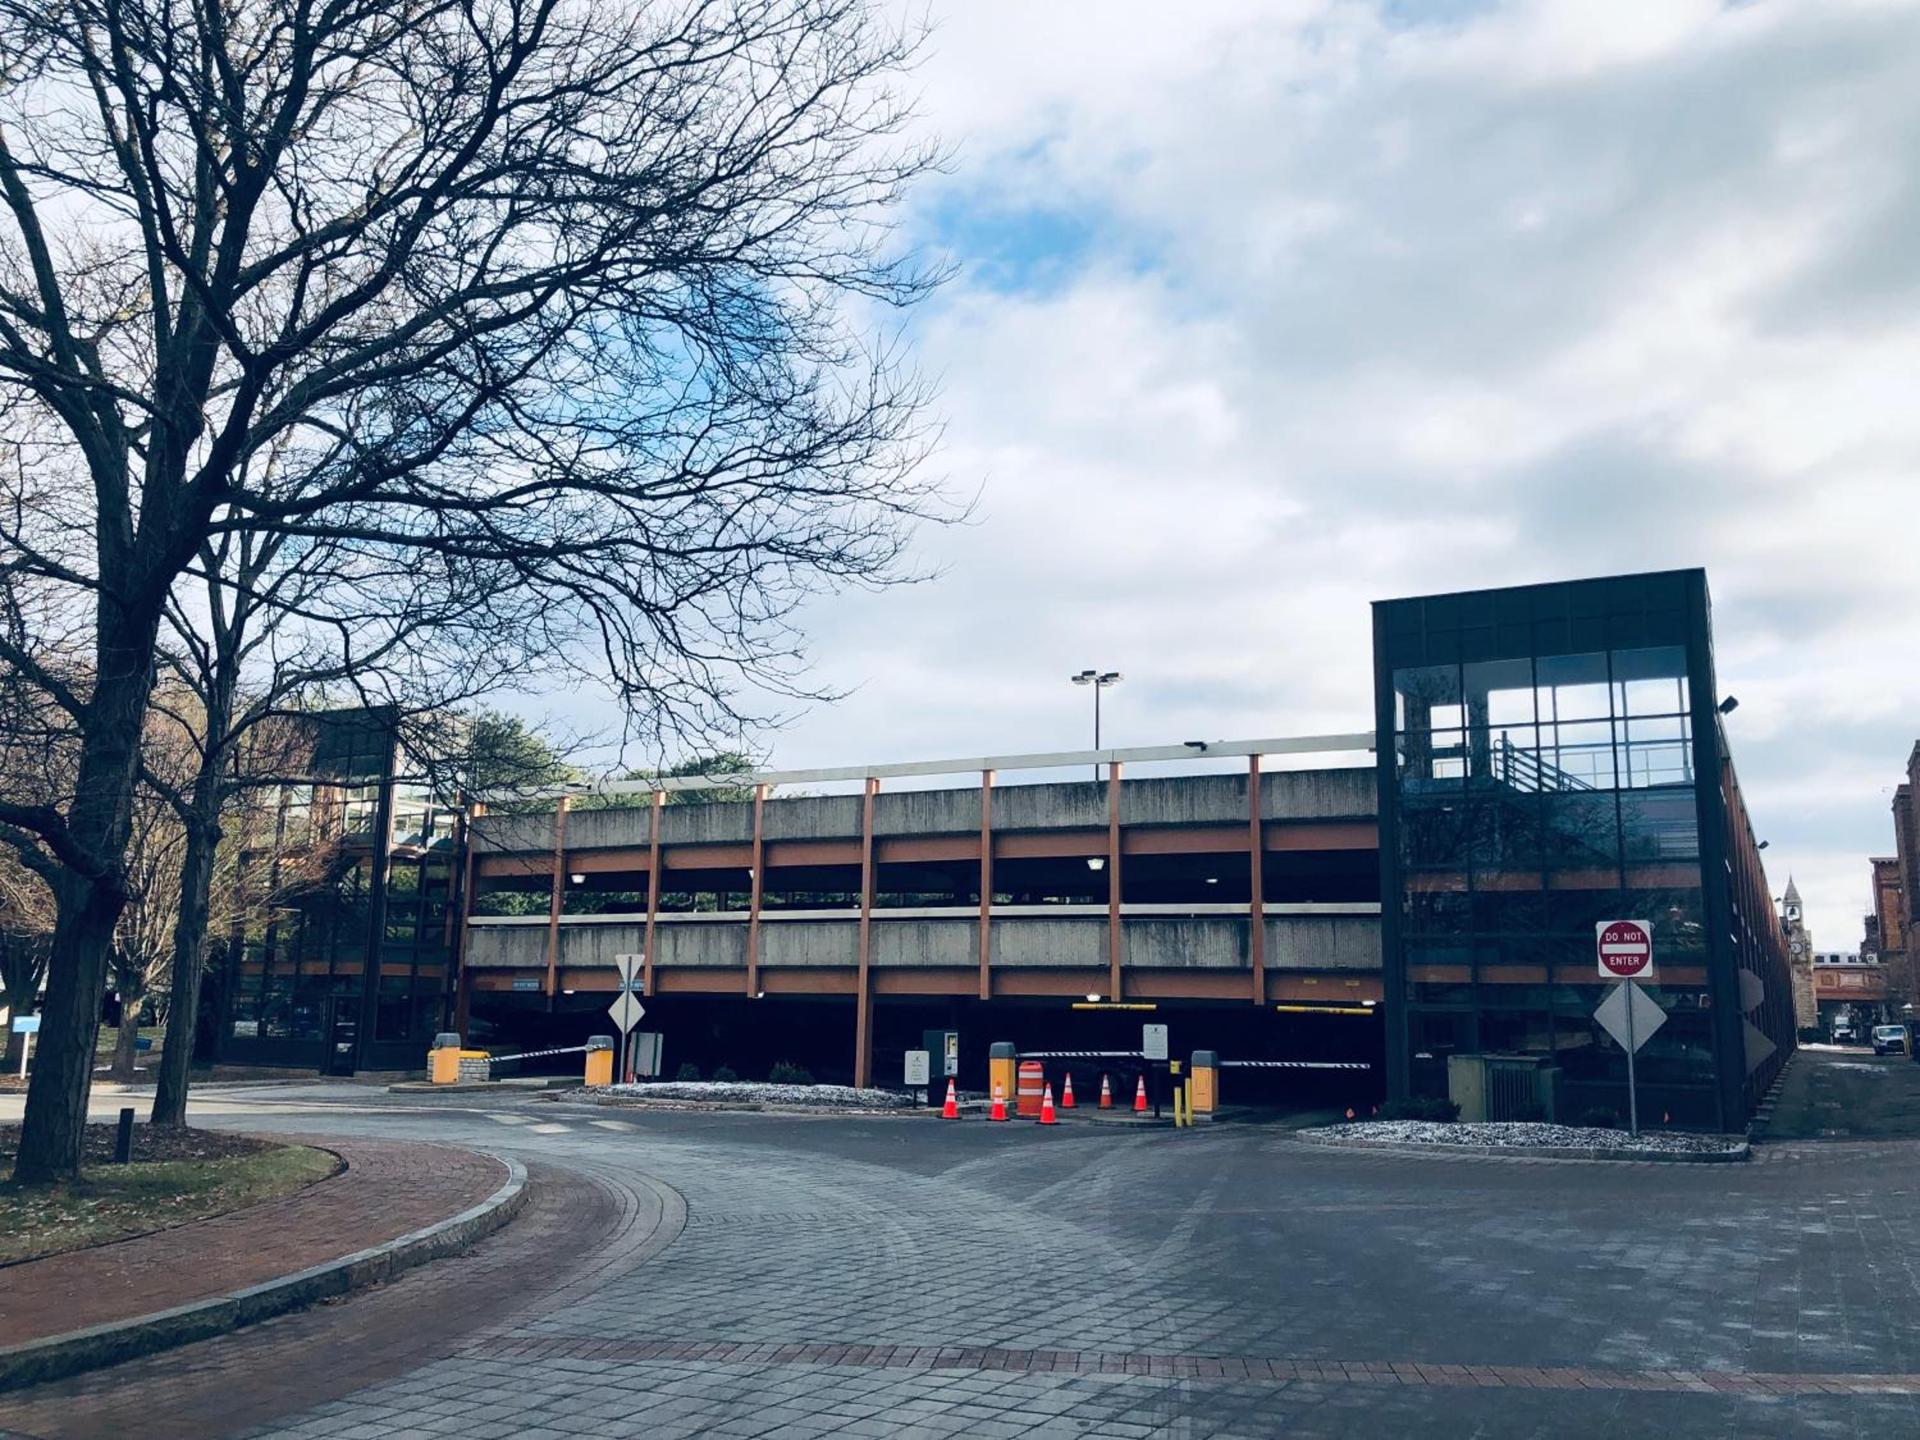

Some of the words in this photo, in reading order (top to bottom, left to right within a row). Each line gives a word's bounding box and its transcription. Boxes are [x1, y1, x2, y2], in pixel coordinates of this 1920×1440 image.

[1605, 932, 1618, 942] DO
[1623, 932, 1642, 941] NOT
[1609, 956, 1640, 966] ENTER
